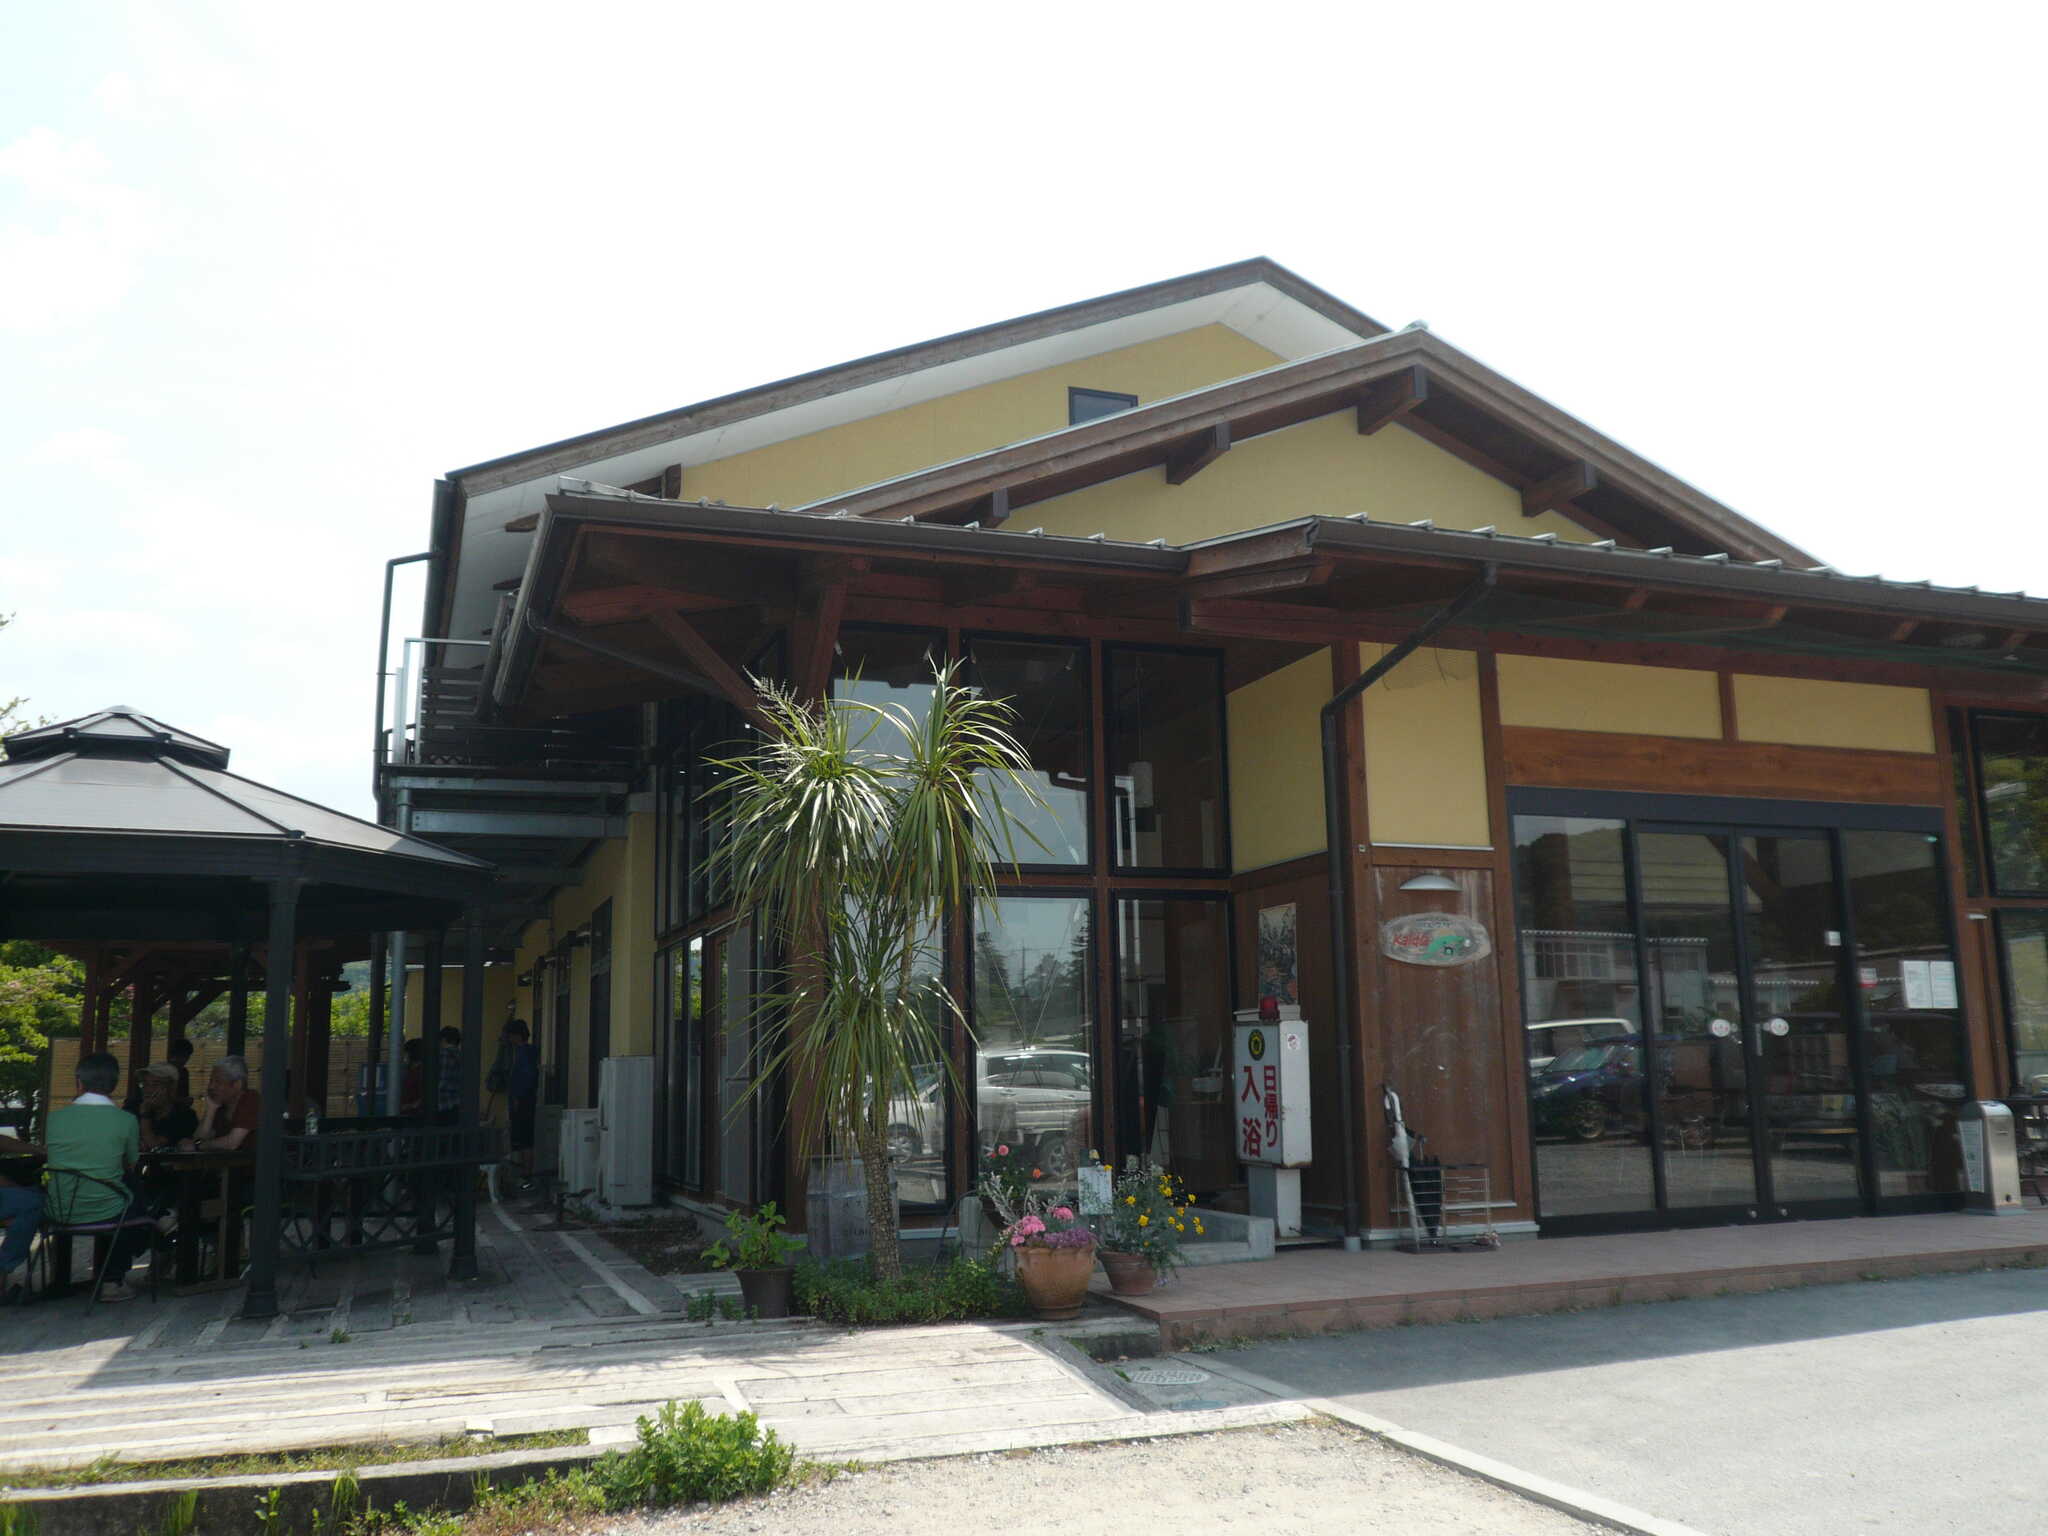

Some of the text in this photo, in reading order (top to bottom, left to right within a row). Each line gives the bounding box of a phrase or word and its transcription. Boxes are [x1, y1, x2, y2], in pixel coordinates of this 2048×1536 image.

[1240, 1065, 1262, 1158] 入浴
[1263, 1065, 1279, 1148] 日帰り
